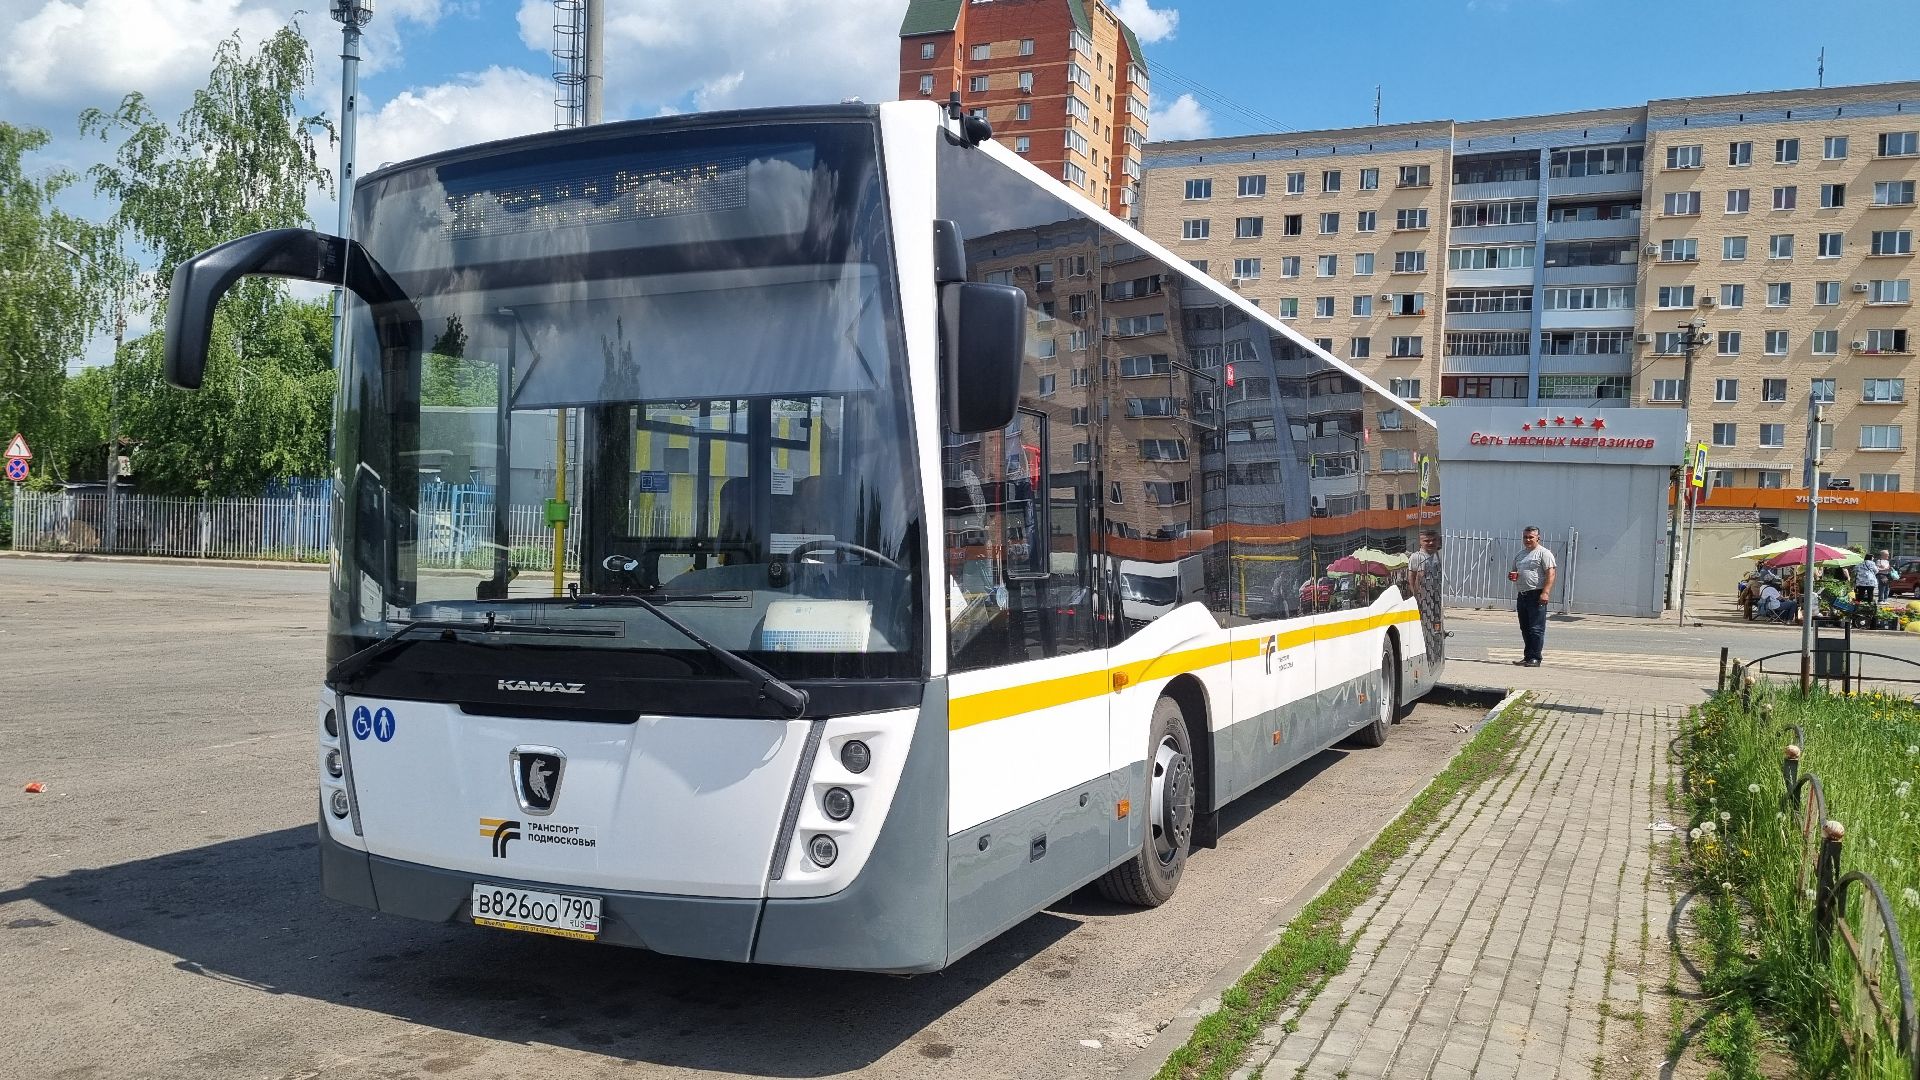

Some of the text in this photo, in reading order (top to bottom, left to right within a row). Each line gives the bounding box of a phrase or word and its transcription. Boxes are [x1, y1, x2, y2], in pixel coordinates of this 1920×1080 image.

[1470, 432, 1655, 449] Сеть мясных магазинов
[1795, 495, 1859, 505] УНВЕРСАМ
[498, 680, 586, 694] KAMAZ
[528, 822, 580, 835] ТРАНСПОРТ
[528, 833, 596, 848] ПОДМОСКОВЬЯ
[569, 919, 585, 929] RUS
